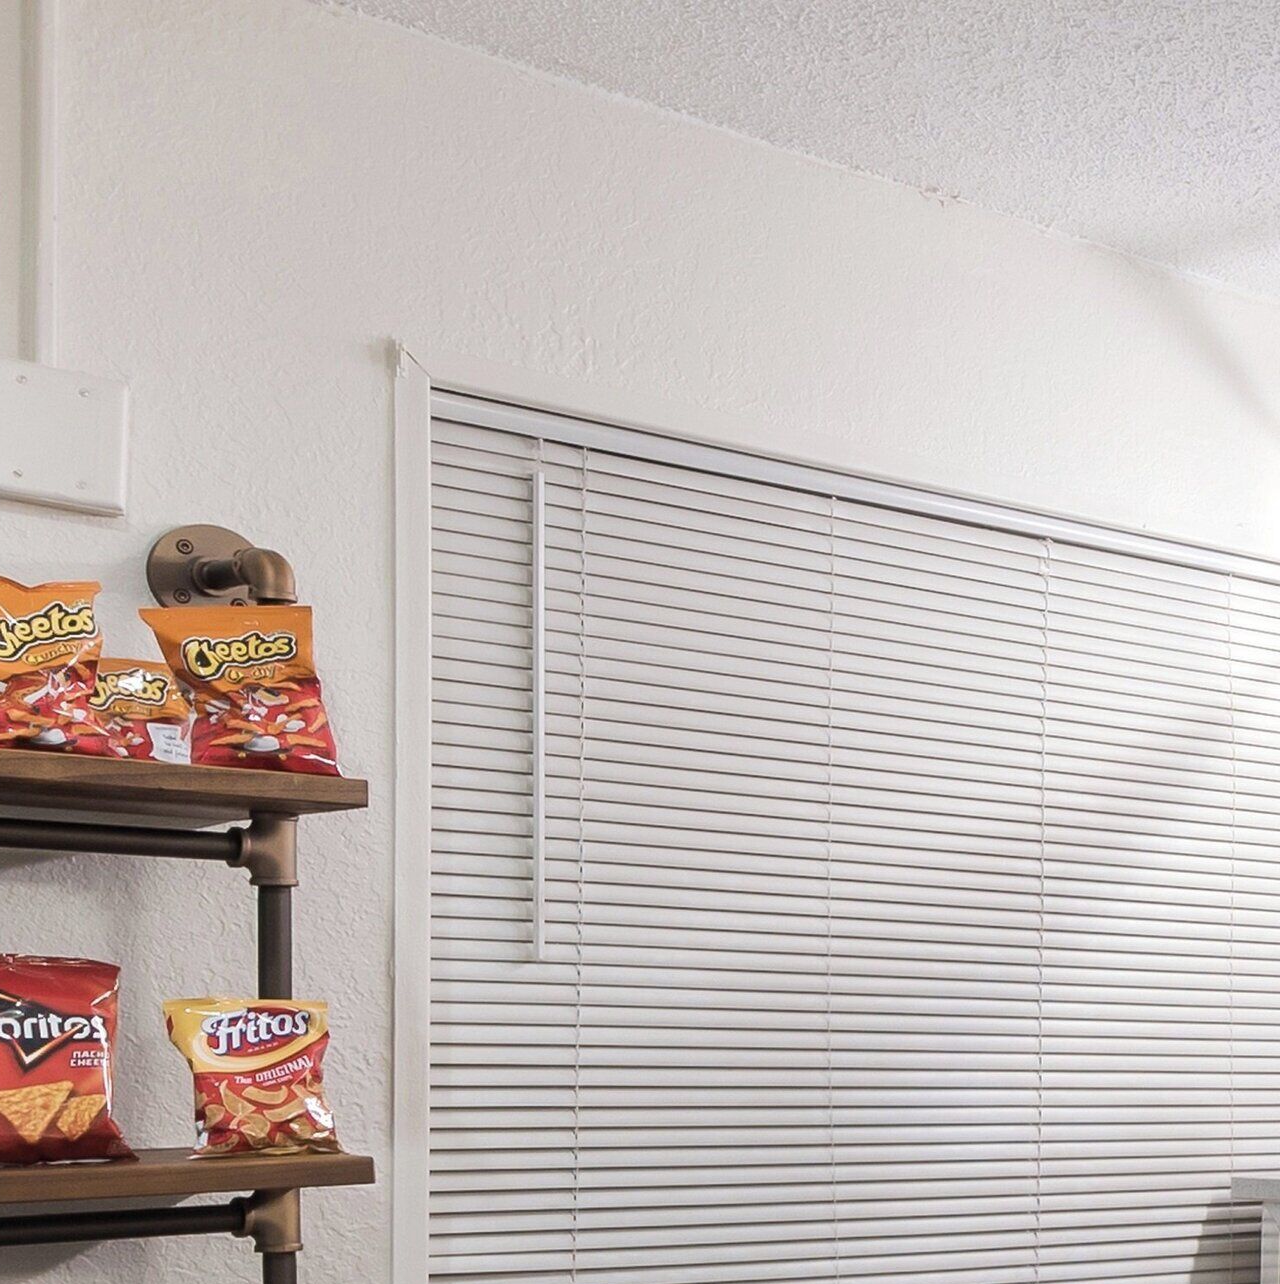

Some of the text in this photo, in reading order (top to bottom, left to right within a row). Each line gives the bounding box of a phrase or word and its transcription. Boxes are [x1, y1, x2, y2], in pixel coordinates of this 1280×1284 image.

[183, 633, 295, 679] Cheetos
[201, 1008, 310, 1055] Fritos
[255, 1055, 314, 1082] ORIGINAL
